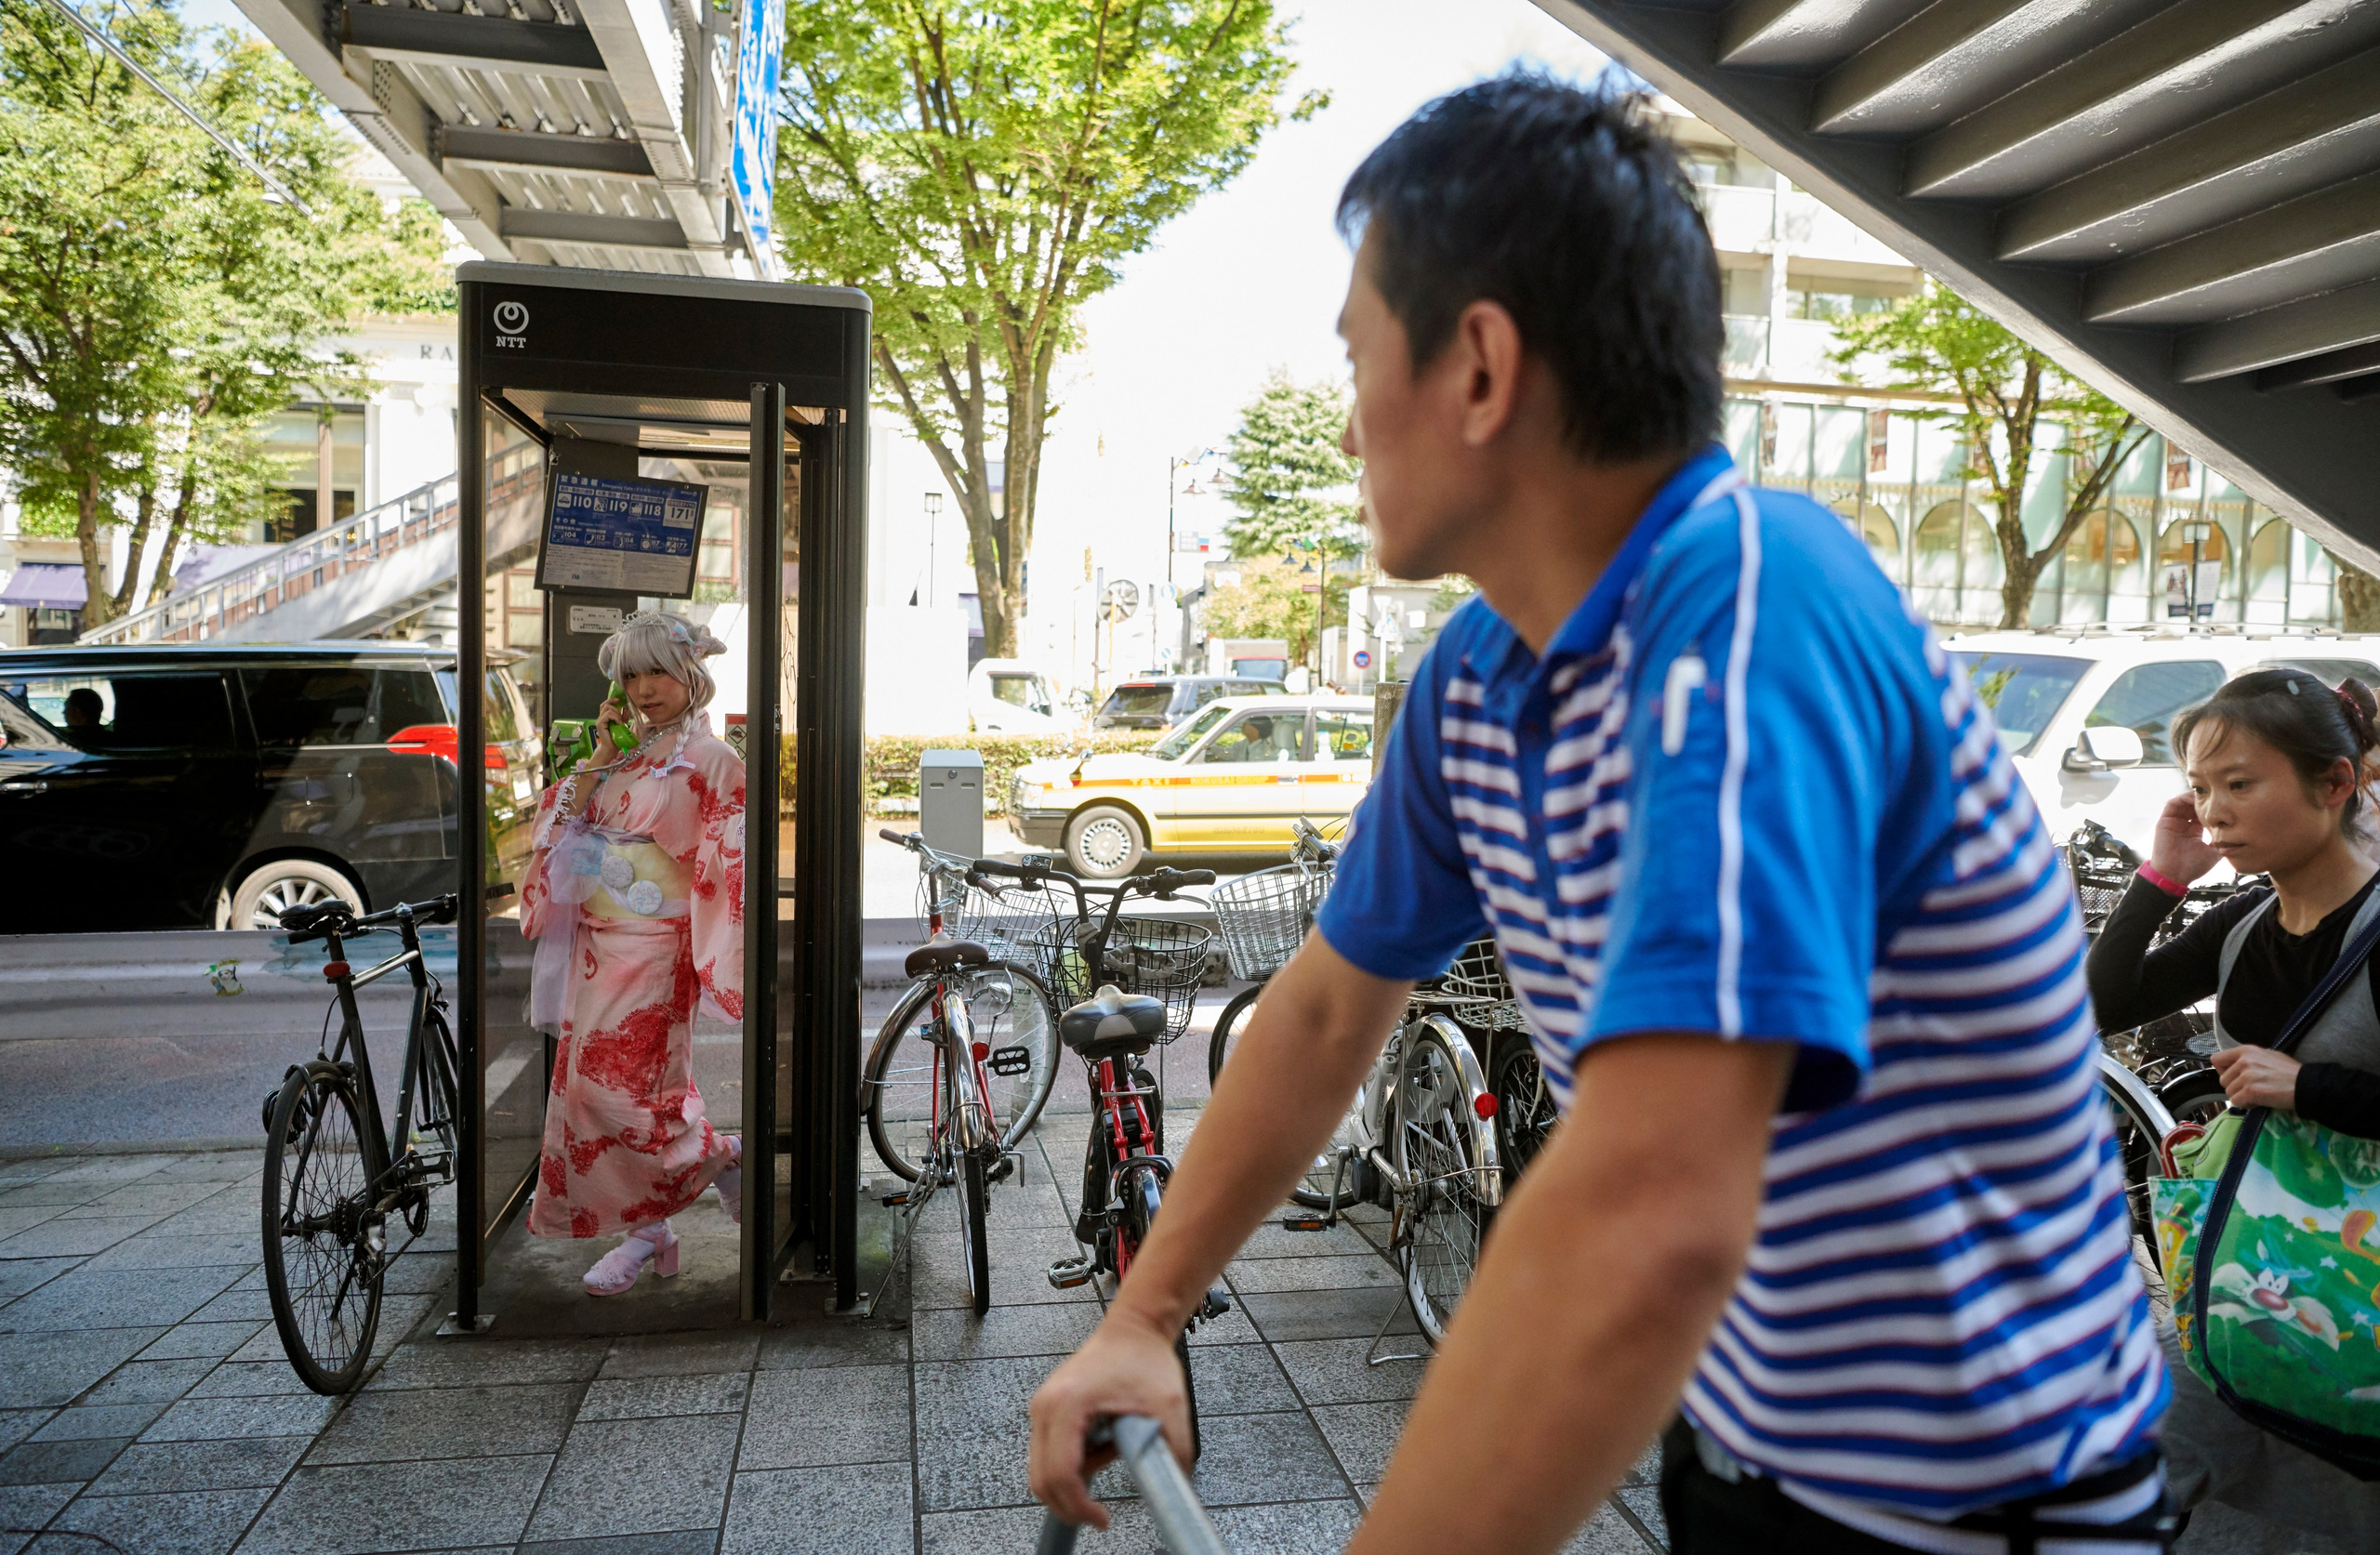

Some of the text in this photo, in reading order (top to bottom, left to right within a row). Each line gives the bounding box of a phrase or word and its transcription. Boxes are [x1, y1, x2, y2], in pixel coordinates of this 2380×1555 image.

[496, 336, 526, 348] NTT
[573, 495, 592, 508] 110
[609, 500, 628, 512] 119
[644, 504, 662, 517] 118
[671, 507, 690, 520] 171
[1130, 777, 1170, 786] TAXI
[1190, 776, 1234, 785] KOKUSAI
